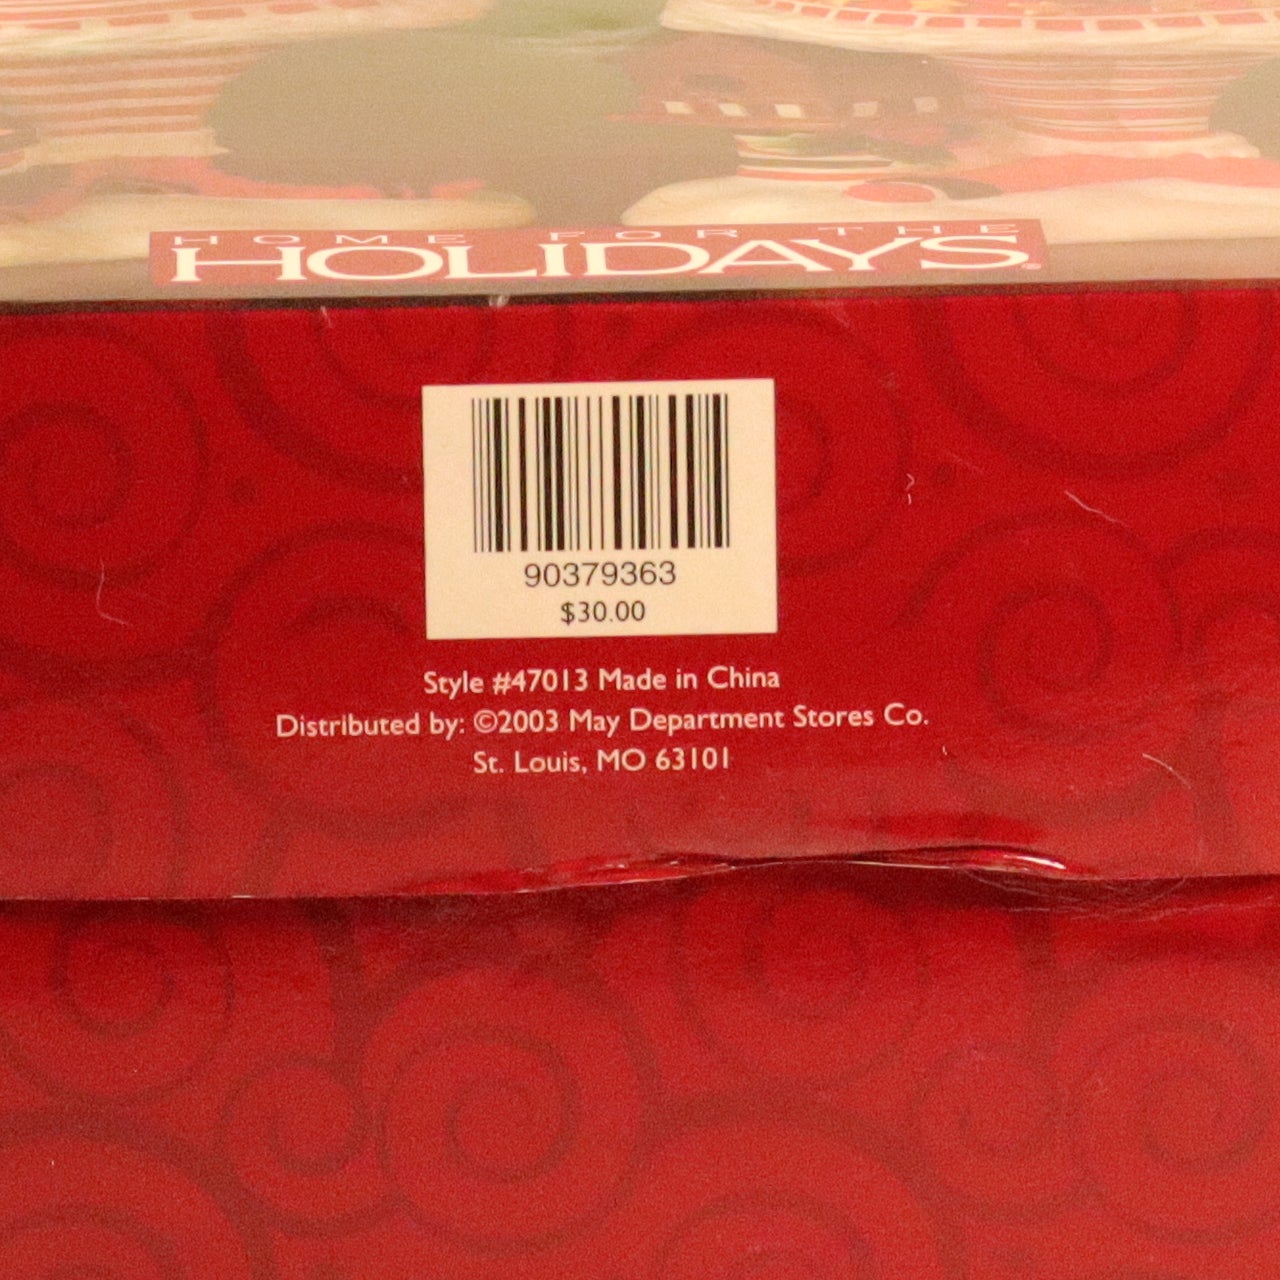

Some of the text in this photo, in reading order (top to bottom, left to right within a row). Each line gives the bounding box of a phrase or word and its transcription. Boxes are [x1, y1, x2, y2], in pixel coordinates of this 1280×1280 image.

[173, 223, 1020, 246] HOME FOR THE
[524, 561, 677, 587] 90379363
[560, 600, 646, 625] $30.00
[423, 665, 780, 700] Style #47013 Made in China
[275, 702, 929, 741] Distributed by: ©2003 May Department Stores Co.
[472, 746, 730, 774] St. Louis, MO 63101
